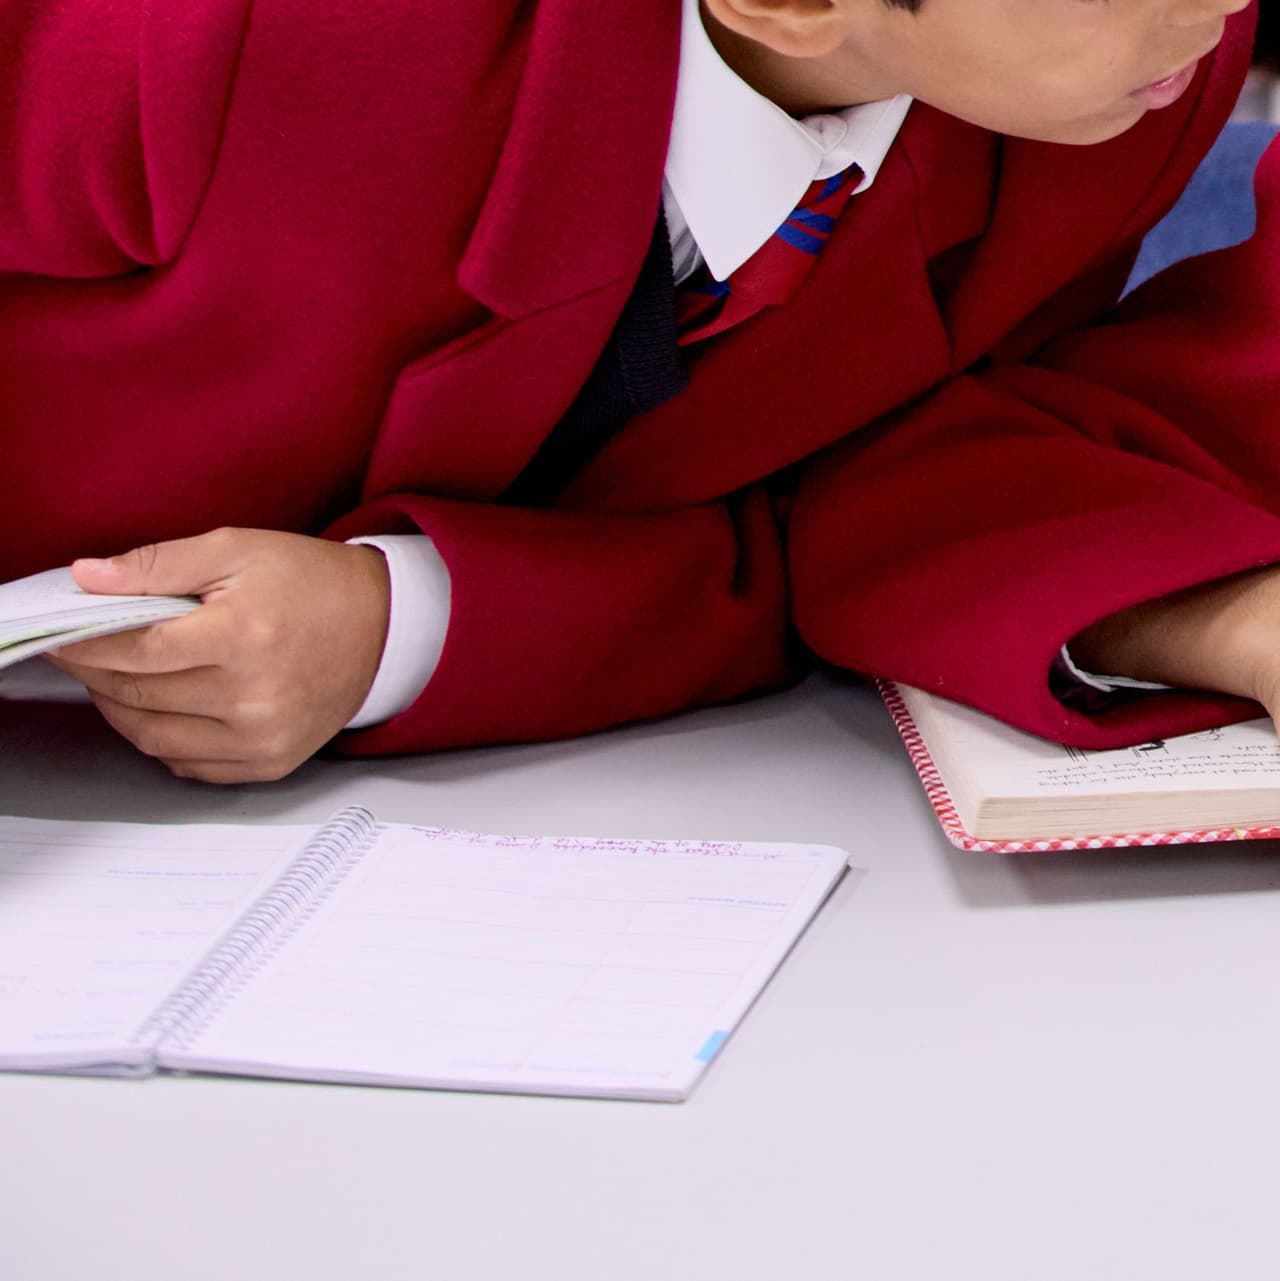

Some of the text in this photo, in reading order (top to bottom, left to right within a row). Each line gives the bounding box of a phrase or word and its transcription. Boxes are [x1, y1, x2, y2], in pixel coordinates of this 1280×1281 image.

[1101, 766, 1163, 774] bathroom
[1183, 762, 1230, 770] created
[1143, 769, 1206, 779] everybody
[1233, 768, 1257, 776] mad
[1048, 772, 1097, 781] schedule
[1038, 780, 1080, 788] taking
